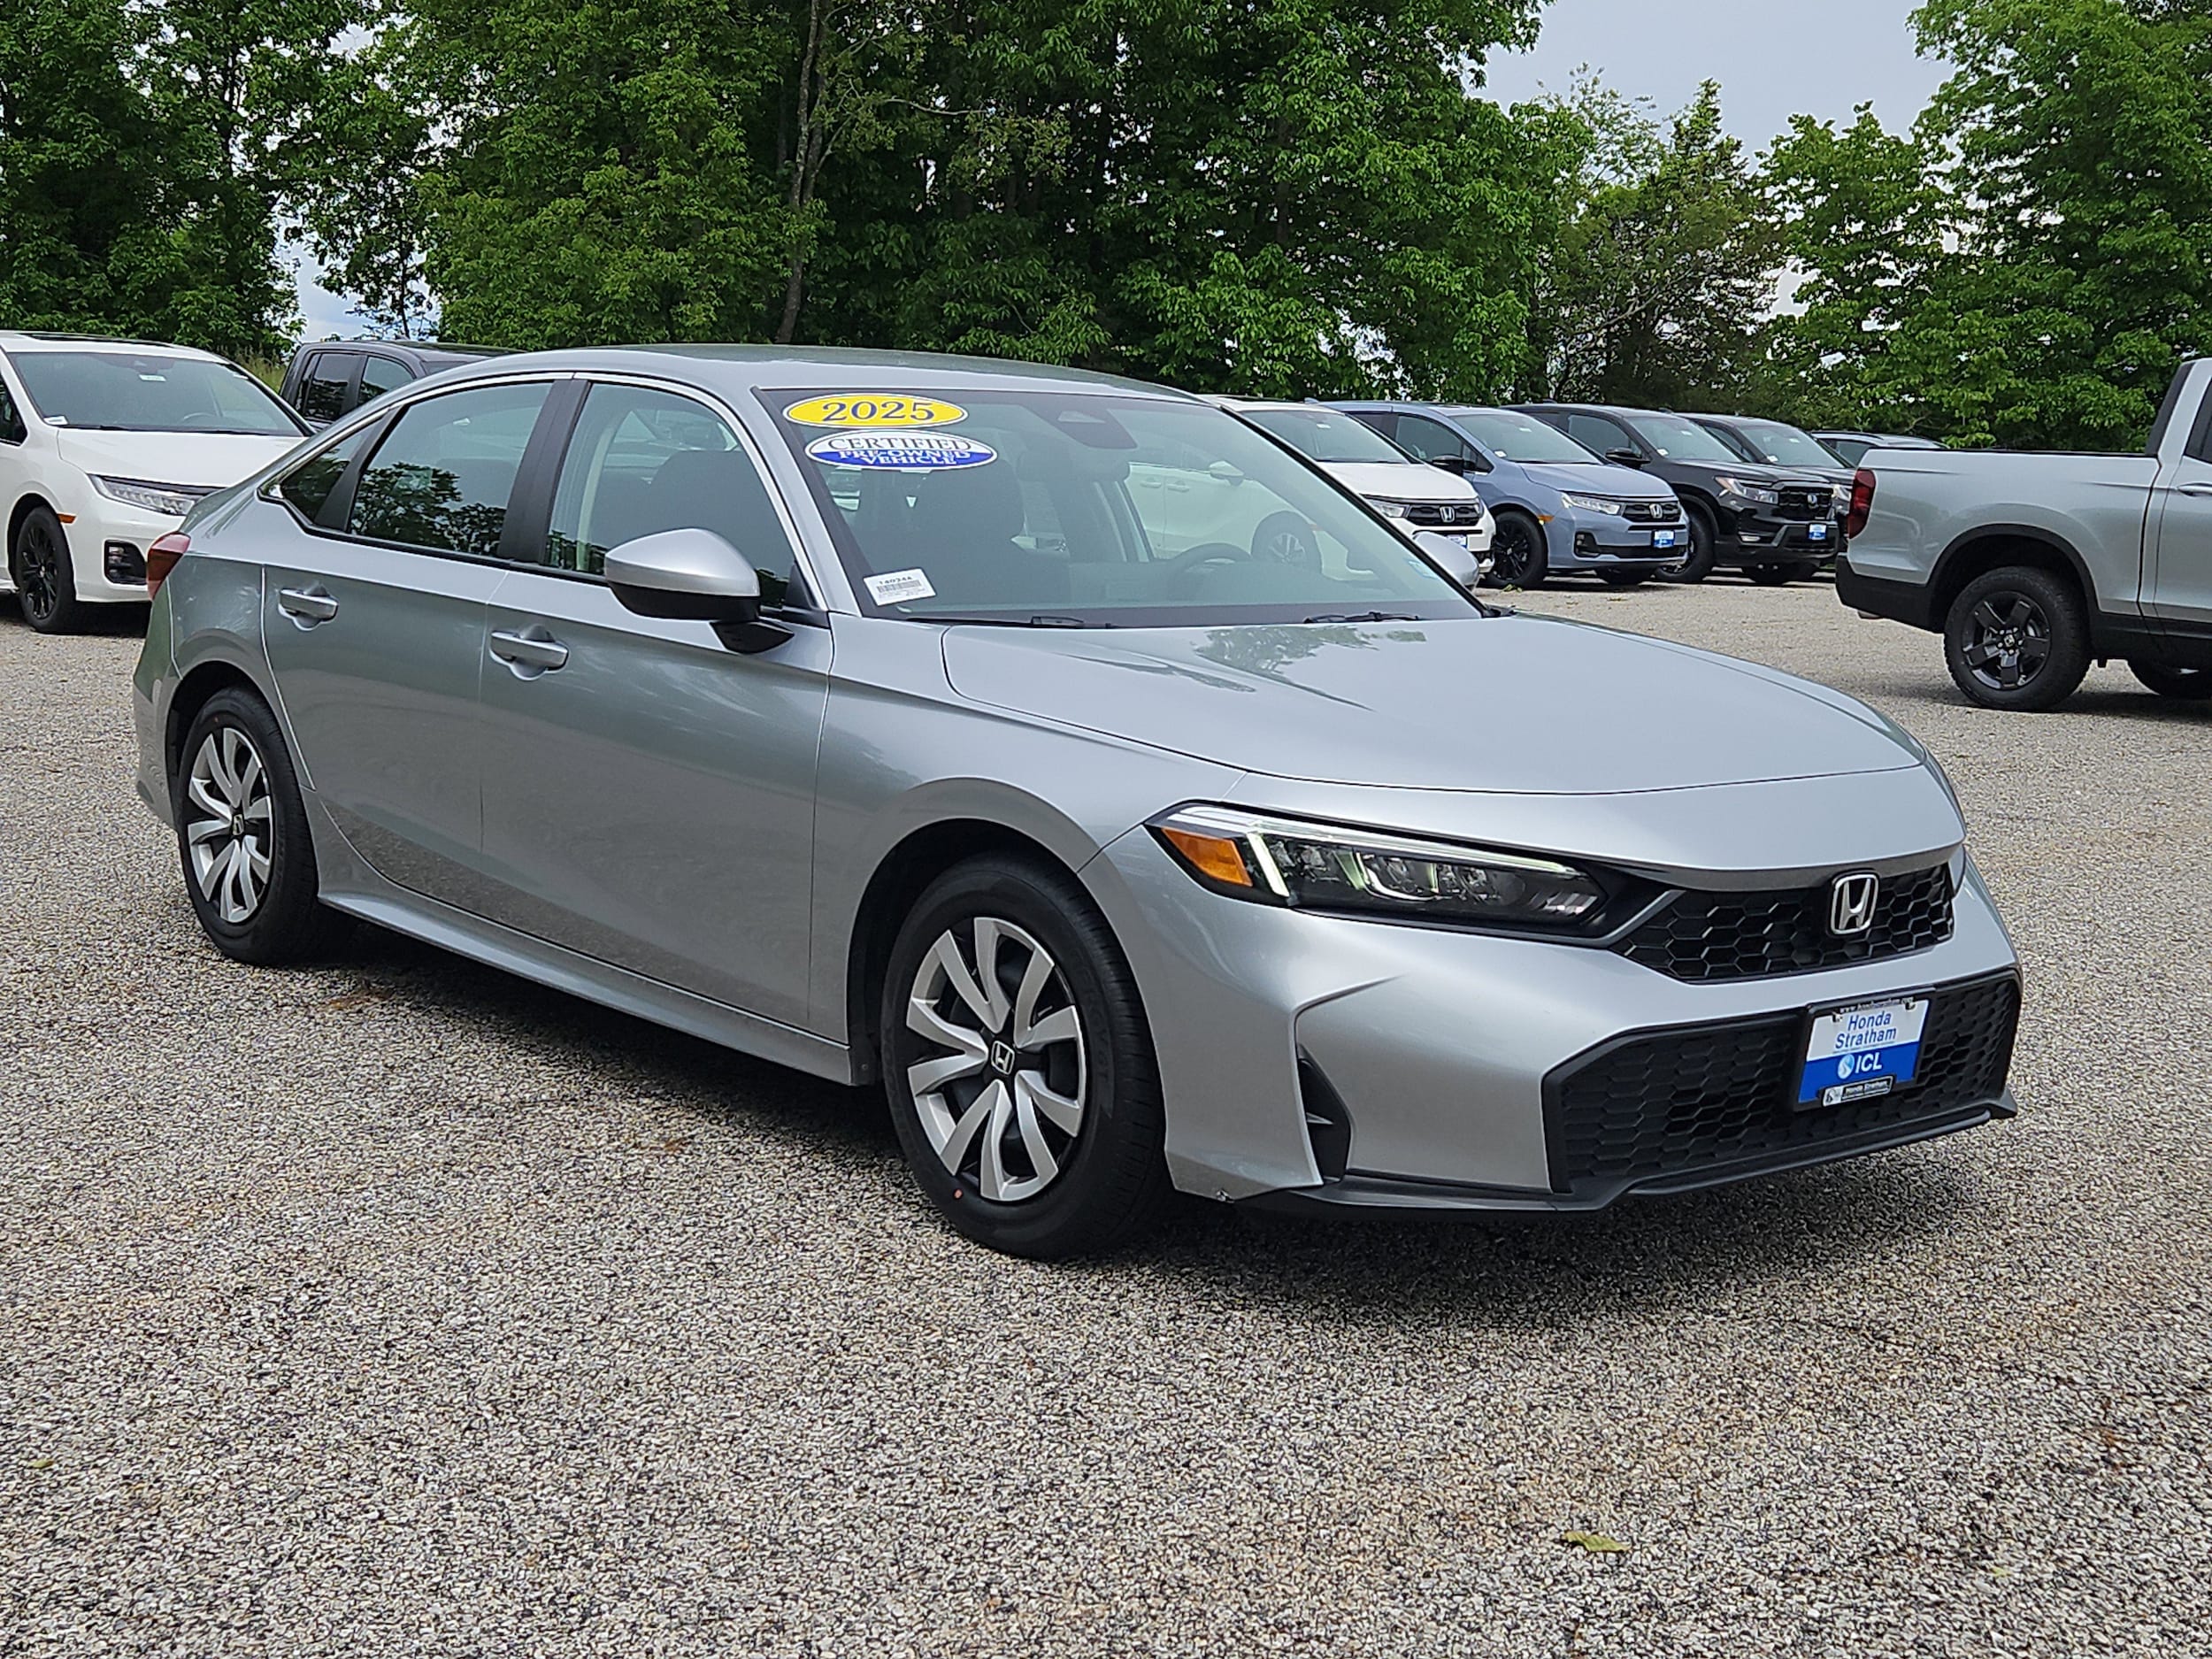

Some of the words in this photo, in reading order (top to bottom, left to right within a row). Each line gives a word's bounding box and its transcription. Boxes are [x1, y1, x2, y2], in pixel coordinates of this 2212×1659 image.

[822, 402, 934, 421] 2025
[828, 438, 972, 451] CERTIFIED
[841, 449, 972, 460] PRE-OWNED
[862, 457, 957, 465] VEHICLE
[1848, 1010, 1892, 1031] Honda
[1835, 1027, 1896, 1048] Stratham
[1855, 1052, 1882, 1074] ICL
